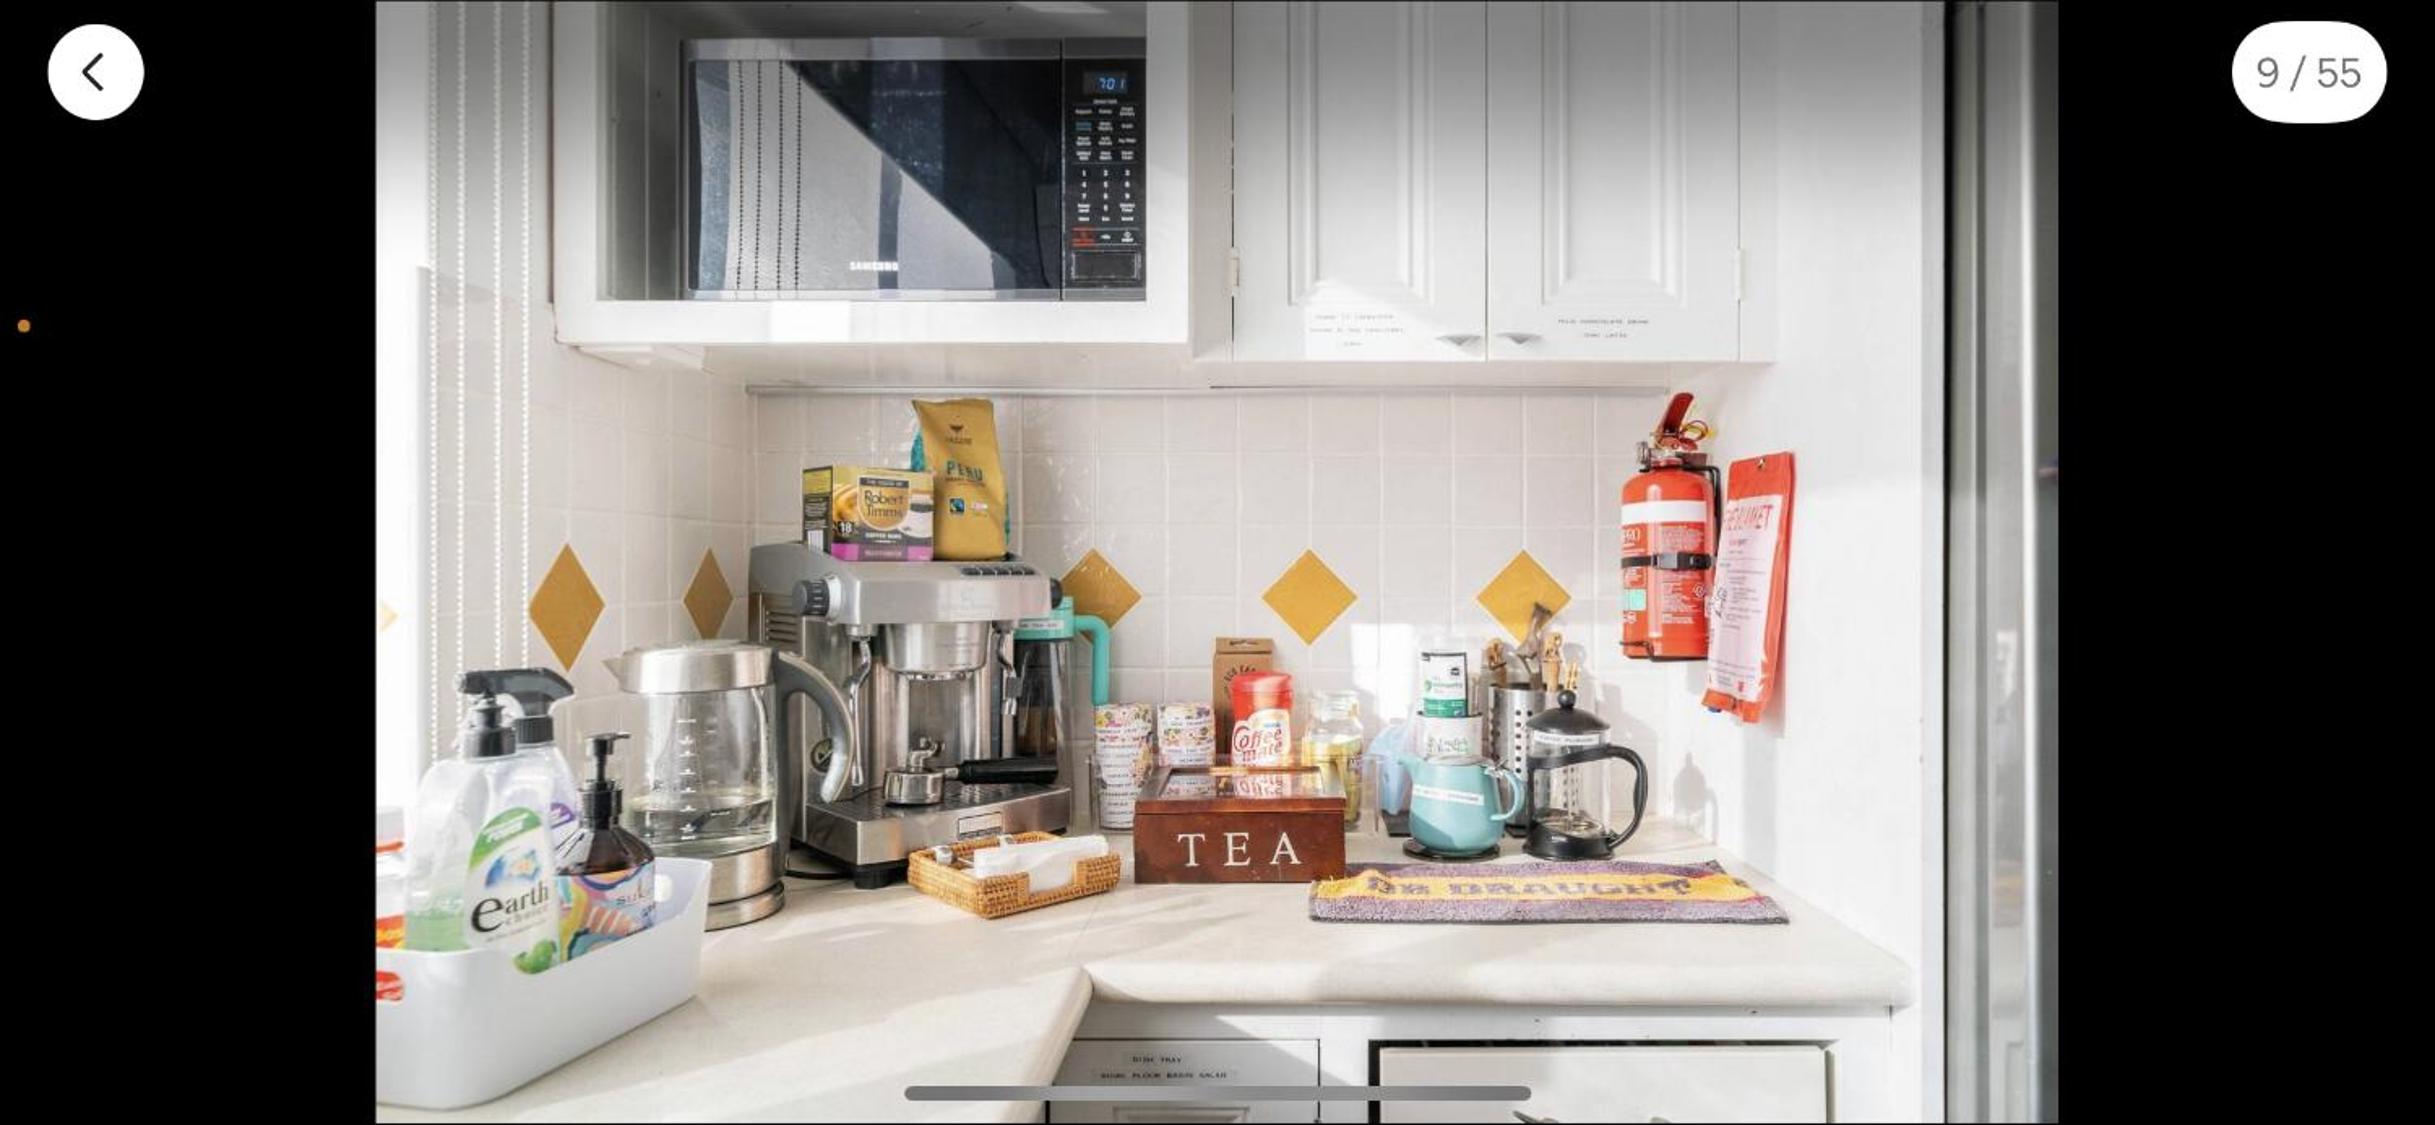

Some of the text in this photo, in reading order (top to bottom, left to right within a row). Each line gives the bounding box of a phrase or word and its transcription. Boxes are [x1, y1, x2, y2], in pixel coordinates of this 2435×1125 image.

[849, 261, 899, 271] SAMSUNG
[947, 460, 983, 481] PERU
[864, 489, 905, 506] Robert
[1233, 725, 1282, 753] Coffee
[1177, 831, 1303, 867] TEA
[1449, 878, 1691, 896] DRAUGHT
[471, 880, 549, 933] earth
